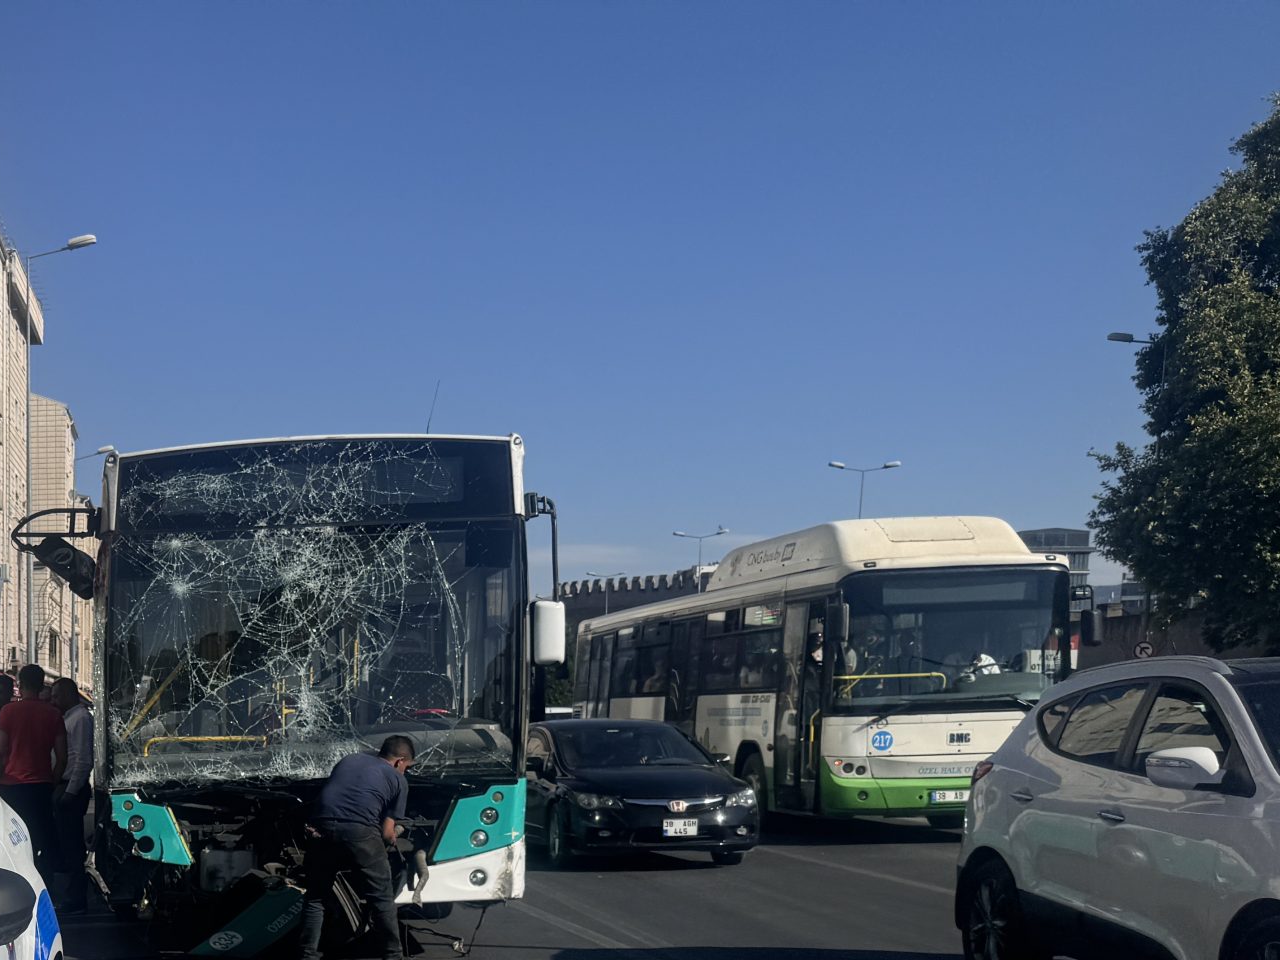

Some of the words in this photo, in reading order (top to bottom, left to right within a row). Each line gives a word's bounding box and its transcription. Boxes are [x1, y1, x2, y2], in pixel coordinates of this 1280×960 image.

[873, 735, 891, 747] 217
[948, 732, 971, 744] BMC
[213, 932, 239, 950] 334
